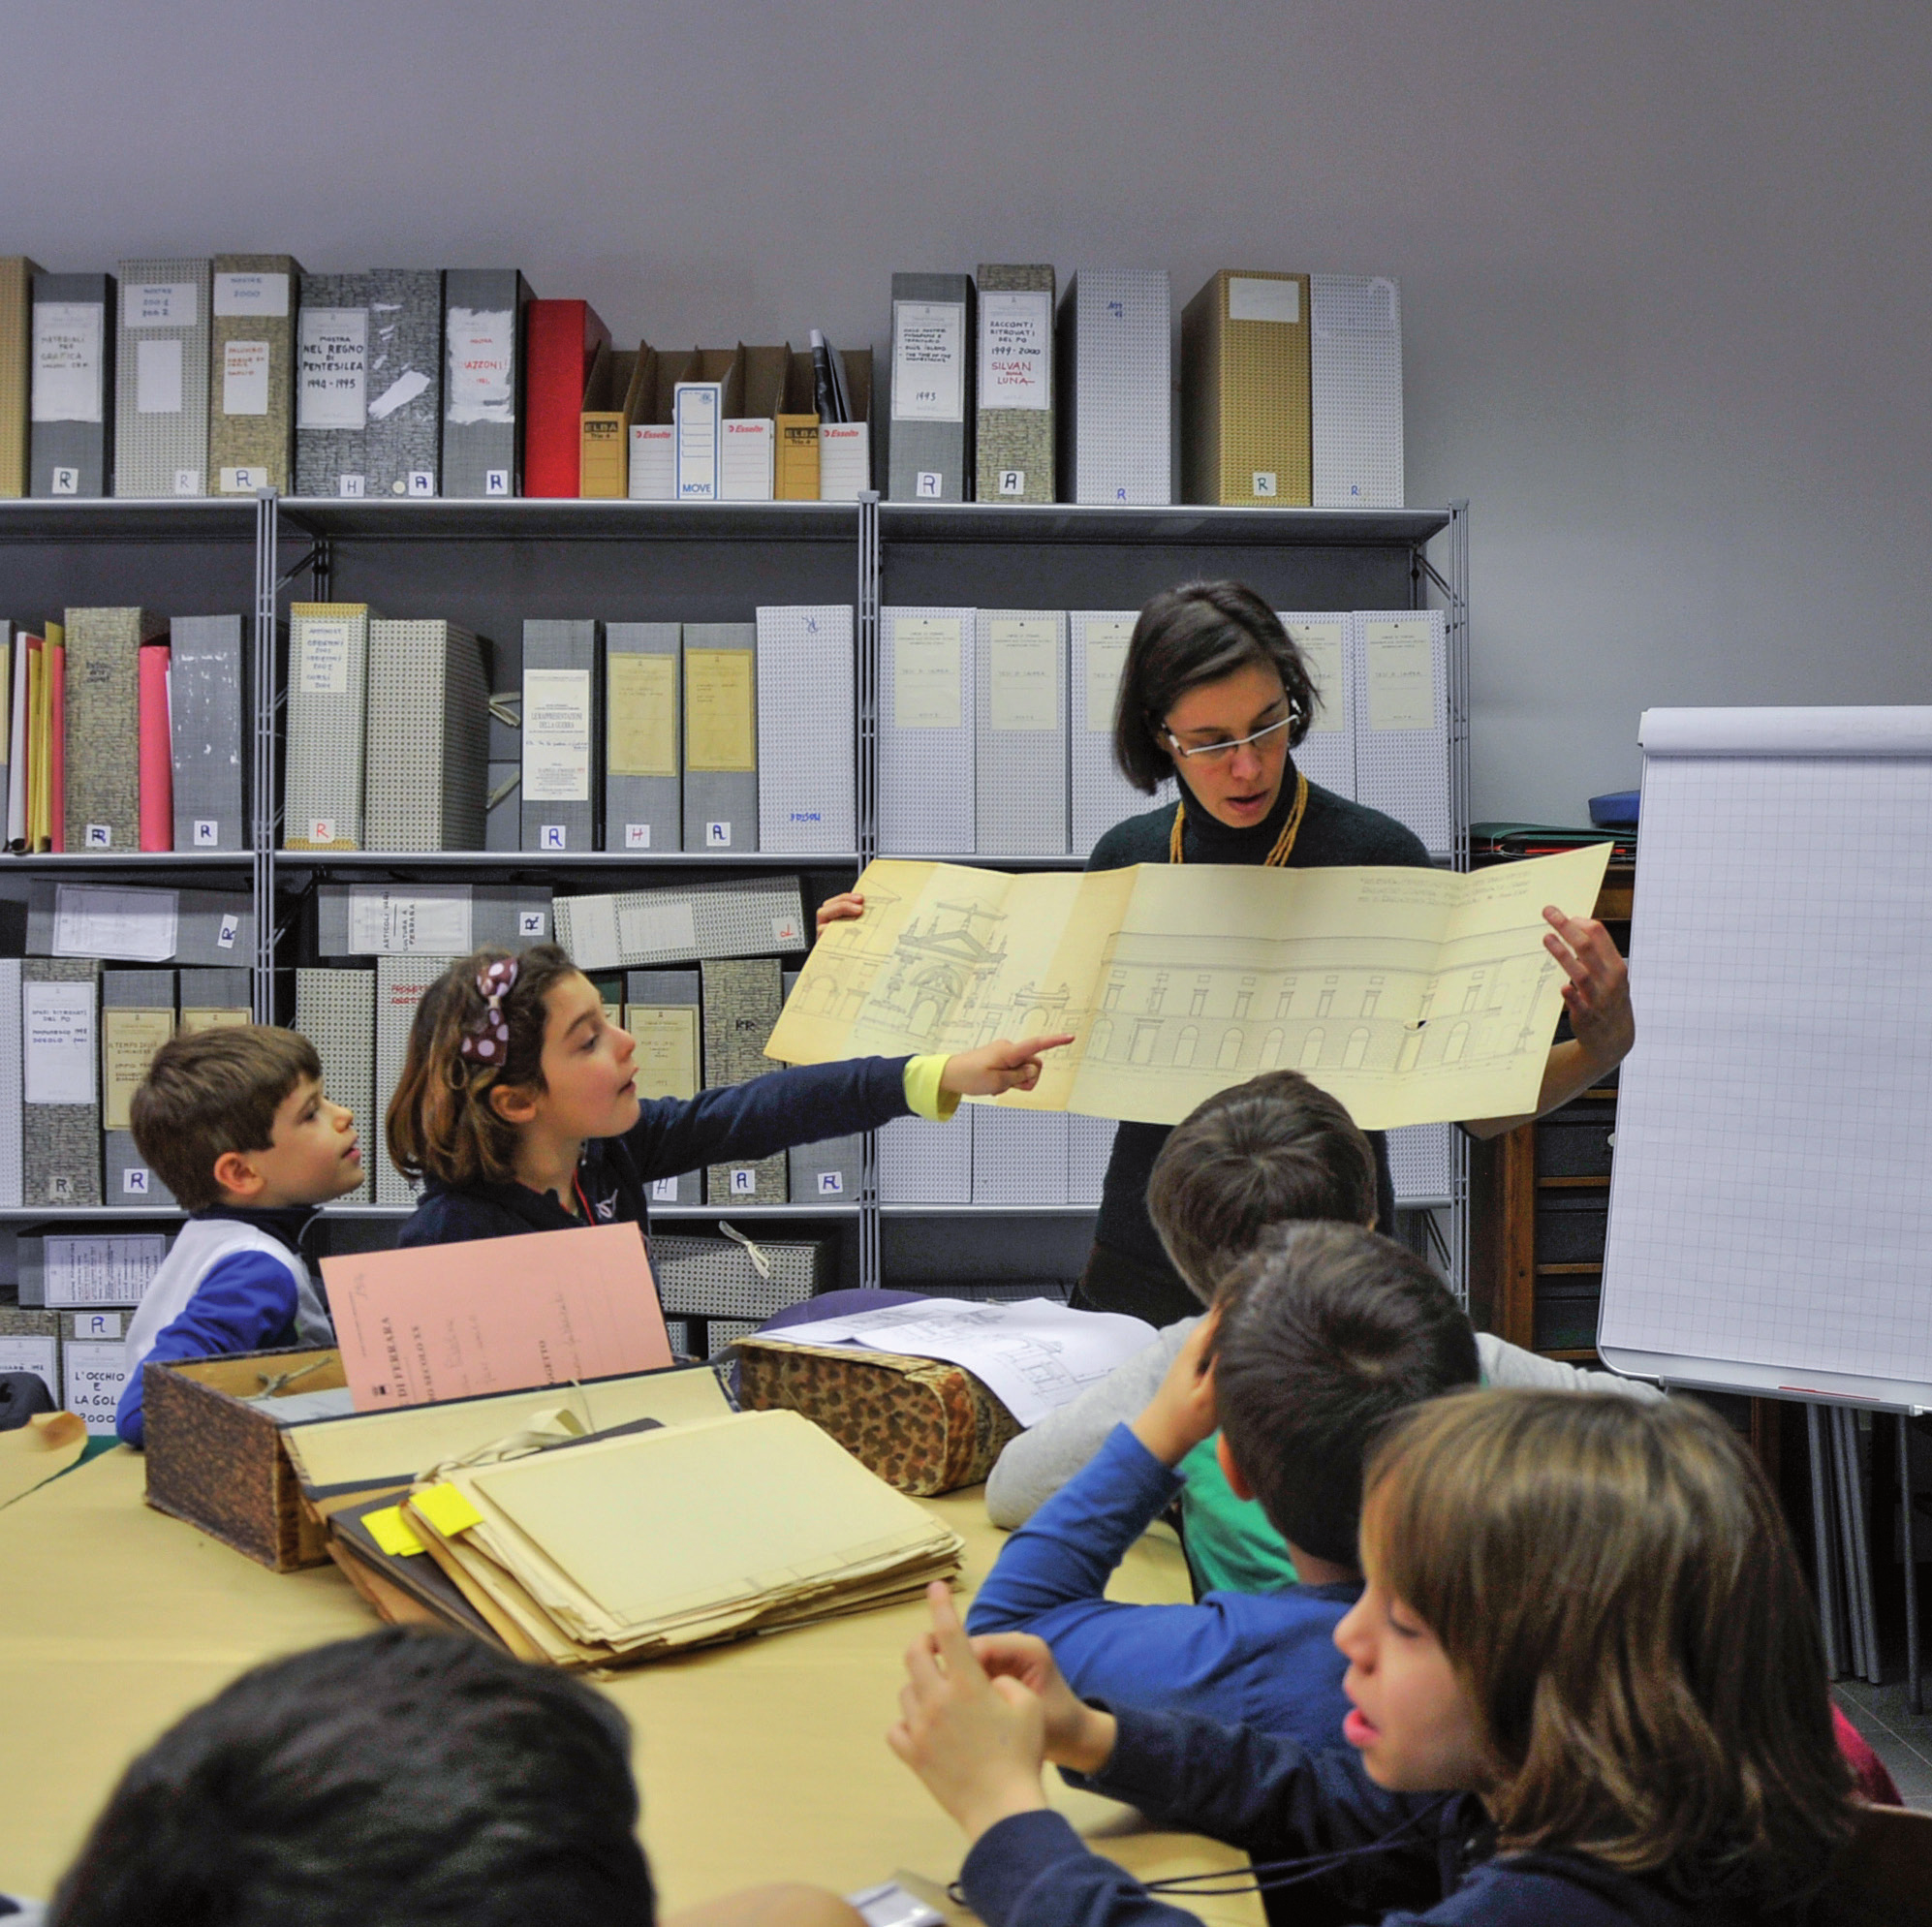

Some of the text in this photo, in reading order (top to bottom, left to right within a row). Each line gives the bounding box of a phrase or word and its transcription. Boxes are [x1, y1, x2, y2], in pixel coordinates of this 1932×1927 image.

[303, 344, 364, 355] NEL REGNO
[302, 360, 363, 372] PENTESILEA
[991, 361, 1032, 372] SILVAN
[997, 377, 1036, 386] LUNA
[584, 421, 617, 432] ELBA
[784, 427, 818, 438] ELBA
[682, 483, 712, 493] MOVE
[1257, 477, 1268, 490] R
[200, 824, 211, 839] R
[316, 823, 329, 839] R
[221, 926, 236, 941] R
[131, 1171, 144, 1190] R
[381, 1317, 404, 1380] FERRARA
[75, 1371, 126, 1383] L'OCCHIO
[93, 1382, 102, 1392] E
[75, 1394, 90, 1405] LA
[79, 1412, 116, 1424] 2000
